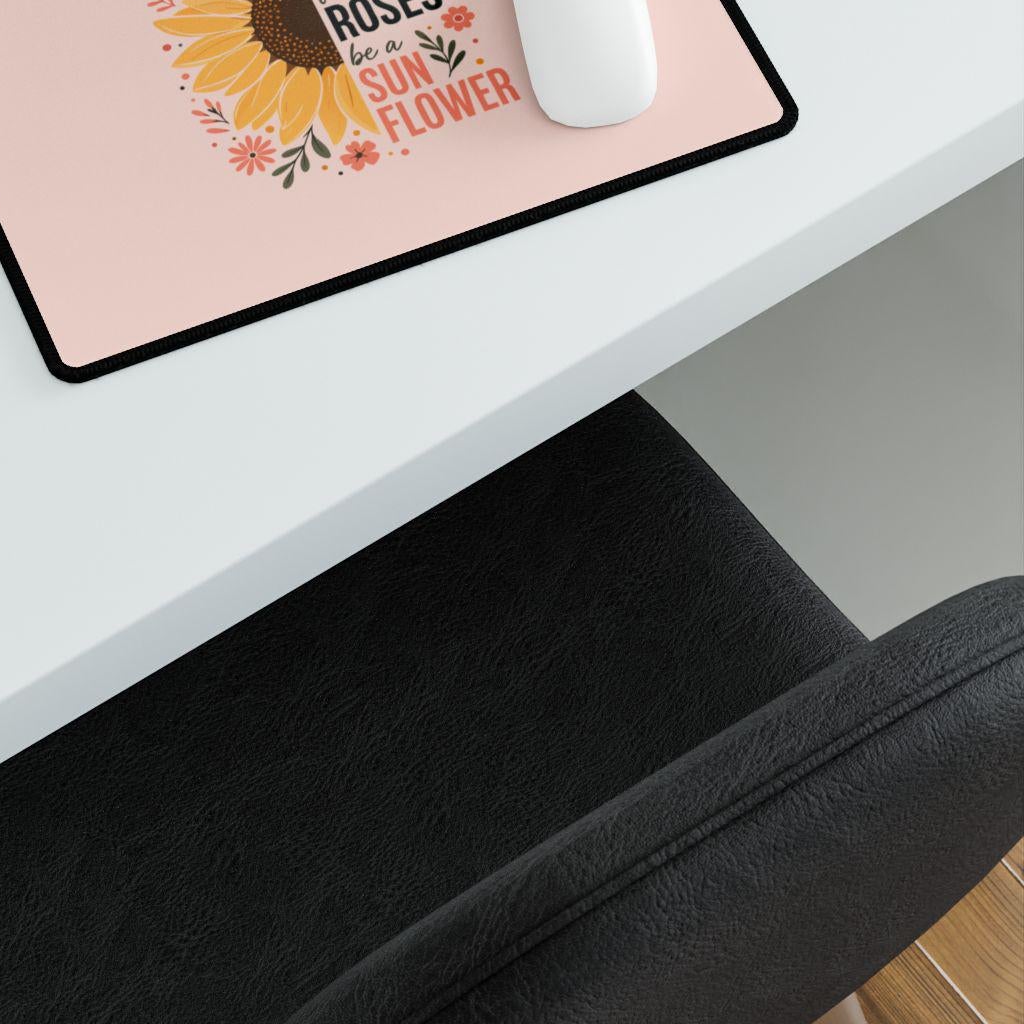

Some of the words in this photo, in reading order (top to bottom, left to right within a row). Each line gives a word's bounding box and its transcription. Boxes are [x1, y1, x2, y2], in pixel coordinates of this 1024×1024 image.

[349, 42, 379, 66] be
[385, 38, 403, 54] a
[358, 50, 436, 103] SUN
[376, 66, 522, 144] FLOWER
